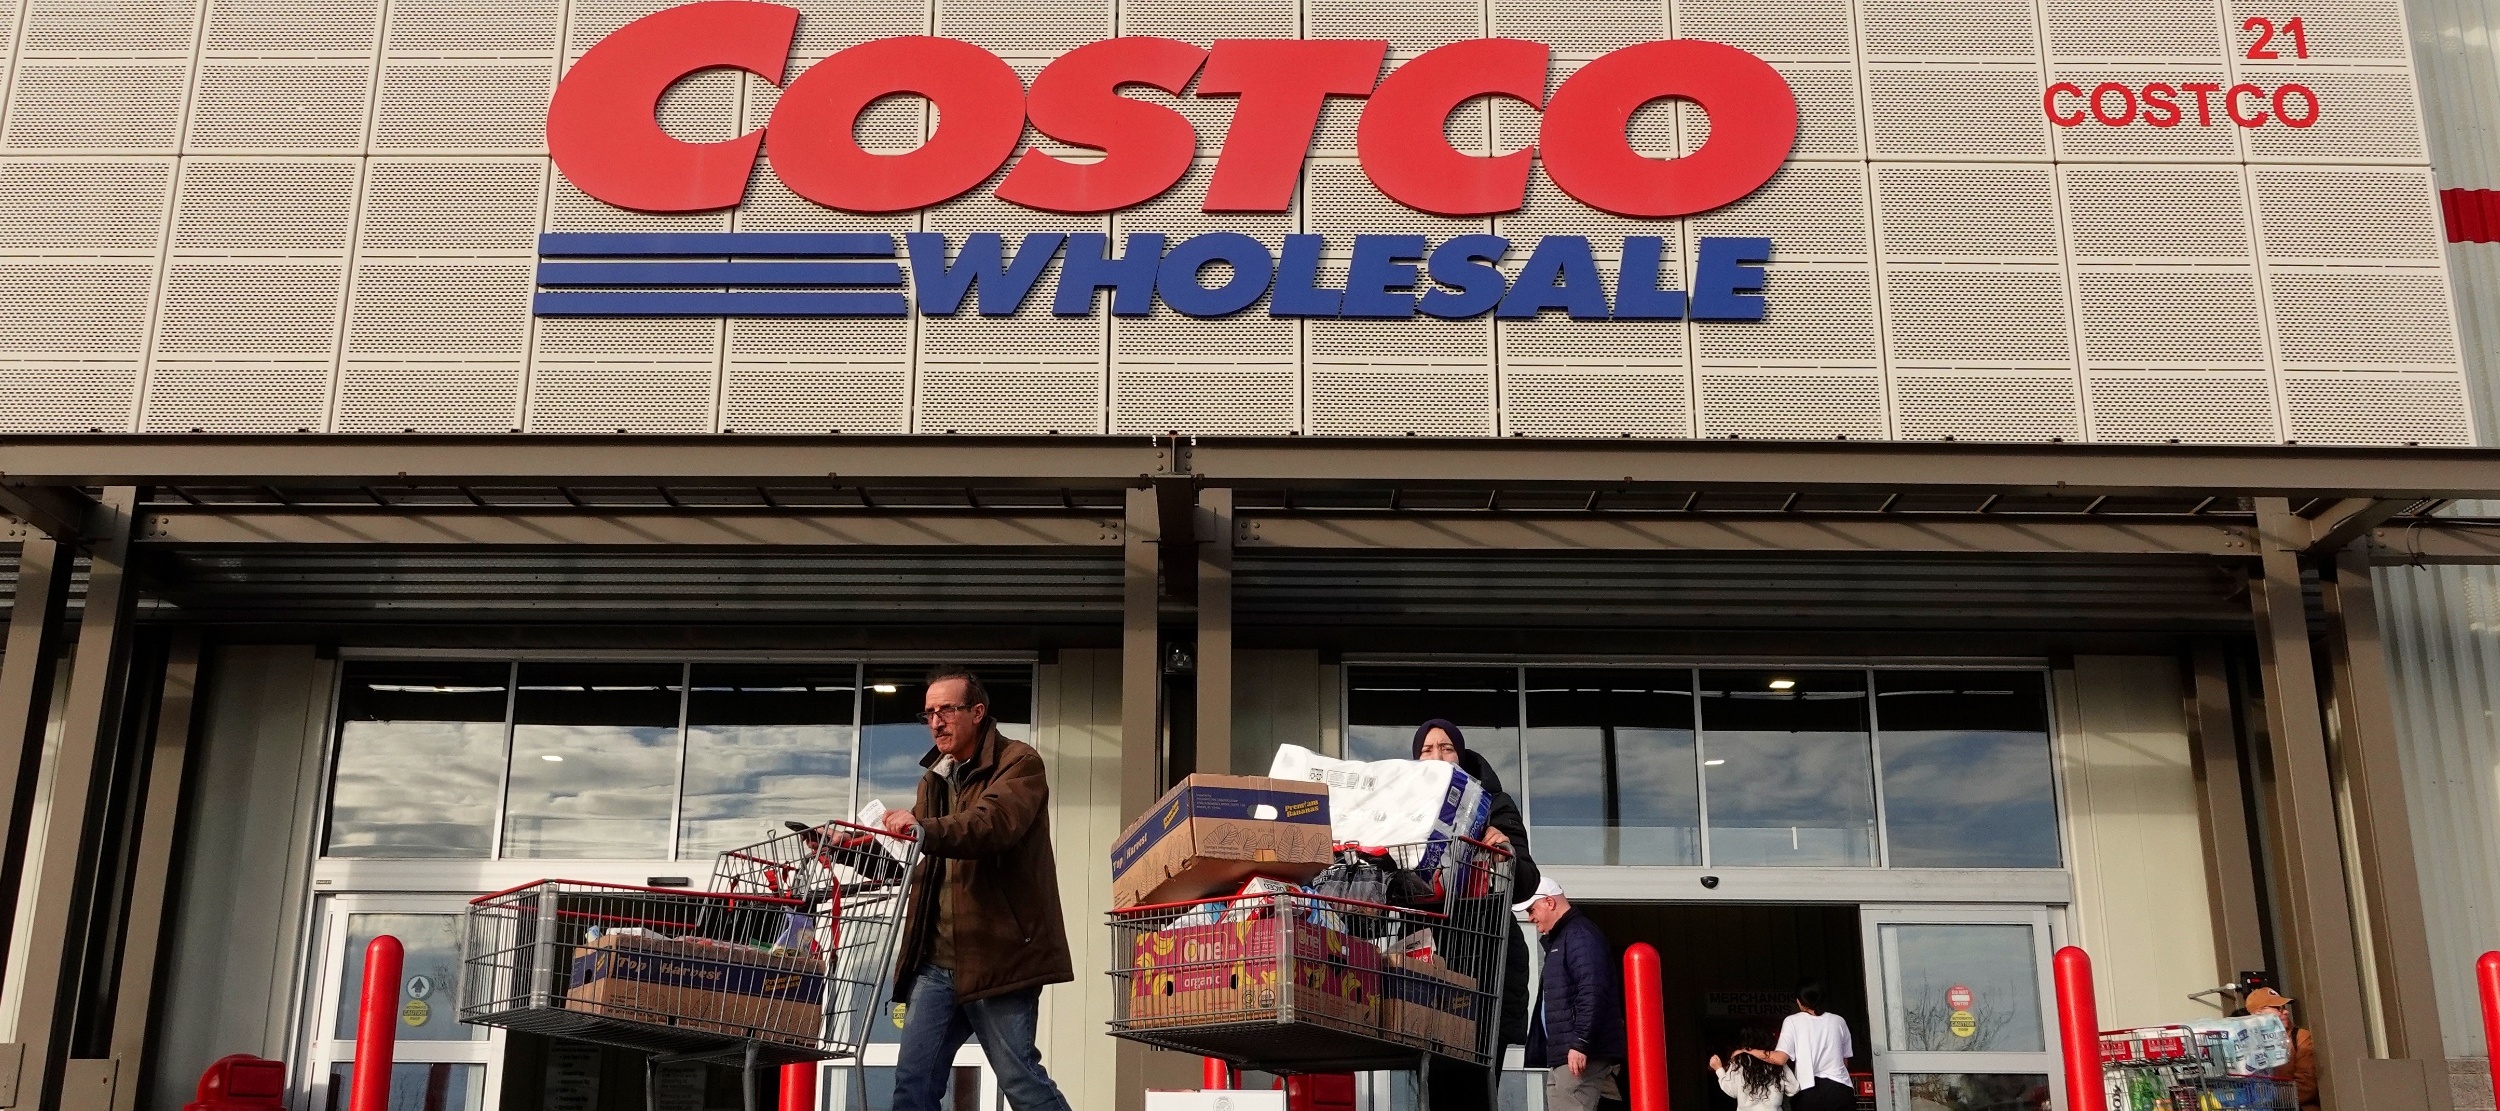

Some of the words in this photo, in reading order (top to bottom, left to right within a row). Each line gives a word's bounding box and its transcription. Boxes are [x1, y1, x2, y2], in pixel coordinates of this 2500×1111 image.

[2243, 16, 2309, 60] 21
[546, 0, 1799, 217] COSTCO
[2043, 81, 2320, 129] COSTCO
[906, 231, 1772, 322] WHOLESALE
[1286, 806, 1320, 818] Bananas
[1126, 832, 1148, 860] Harvest
[1183, 938, 1224, 963] One
[617, 956, 648, 972] Top
[660, 962, 723, 981] Harvest
[1709, 992, 1797, 1004] MERCHANDIS
[1727, 1004, 1791, 1015] RETURNS
